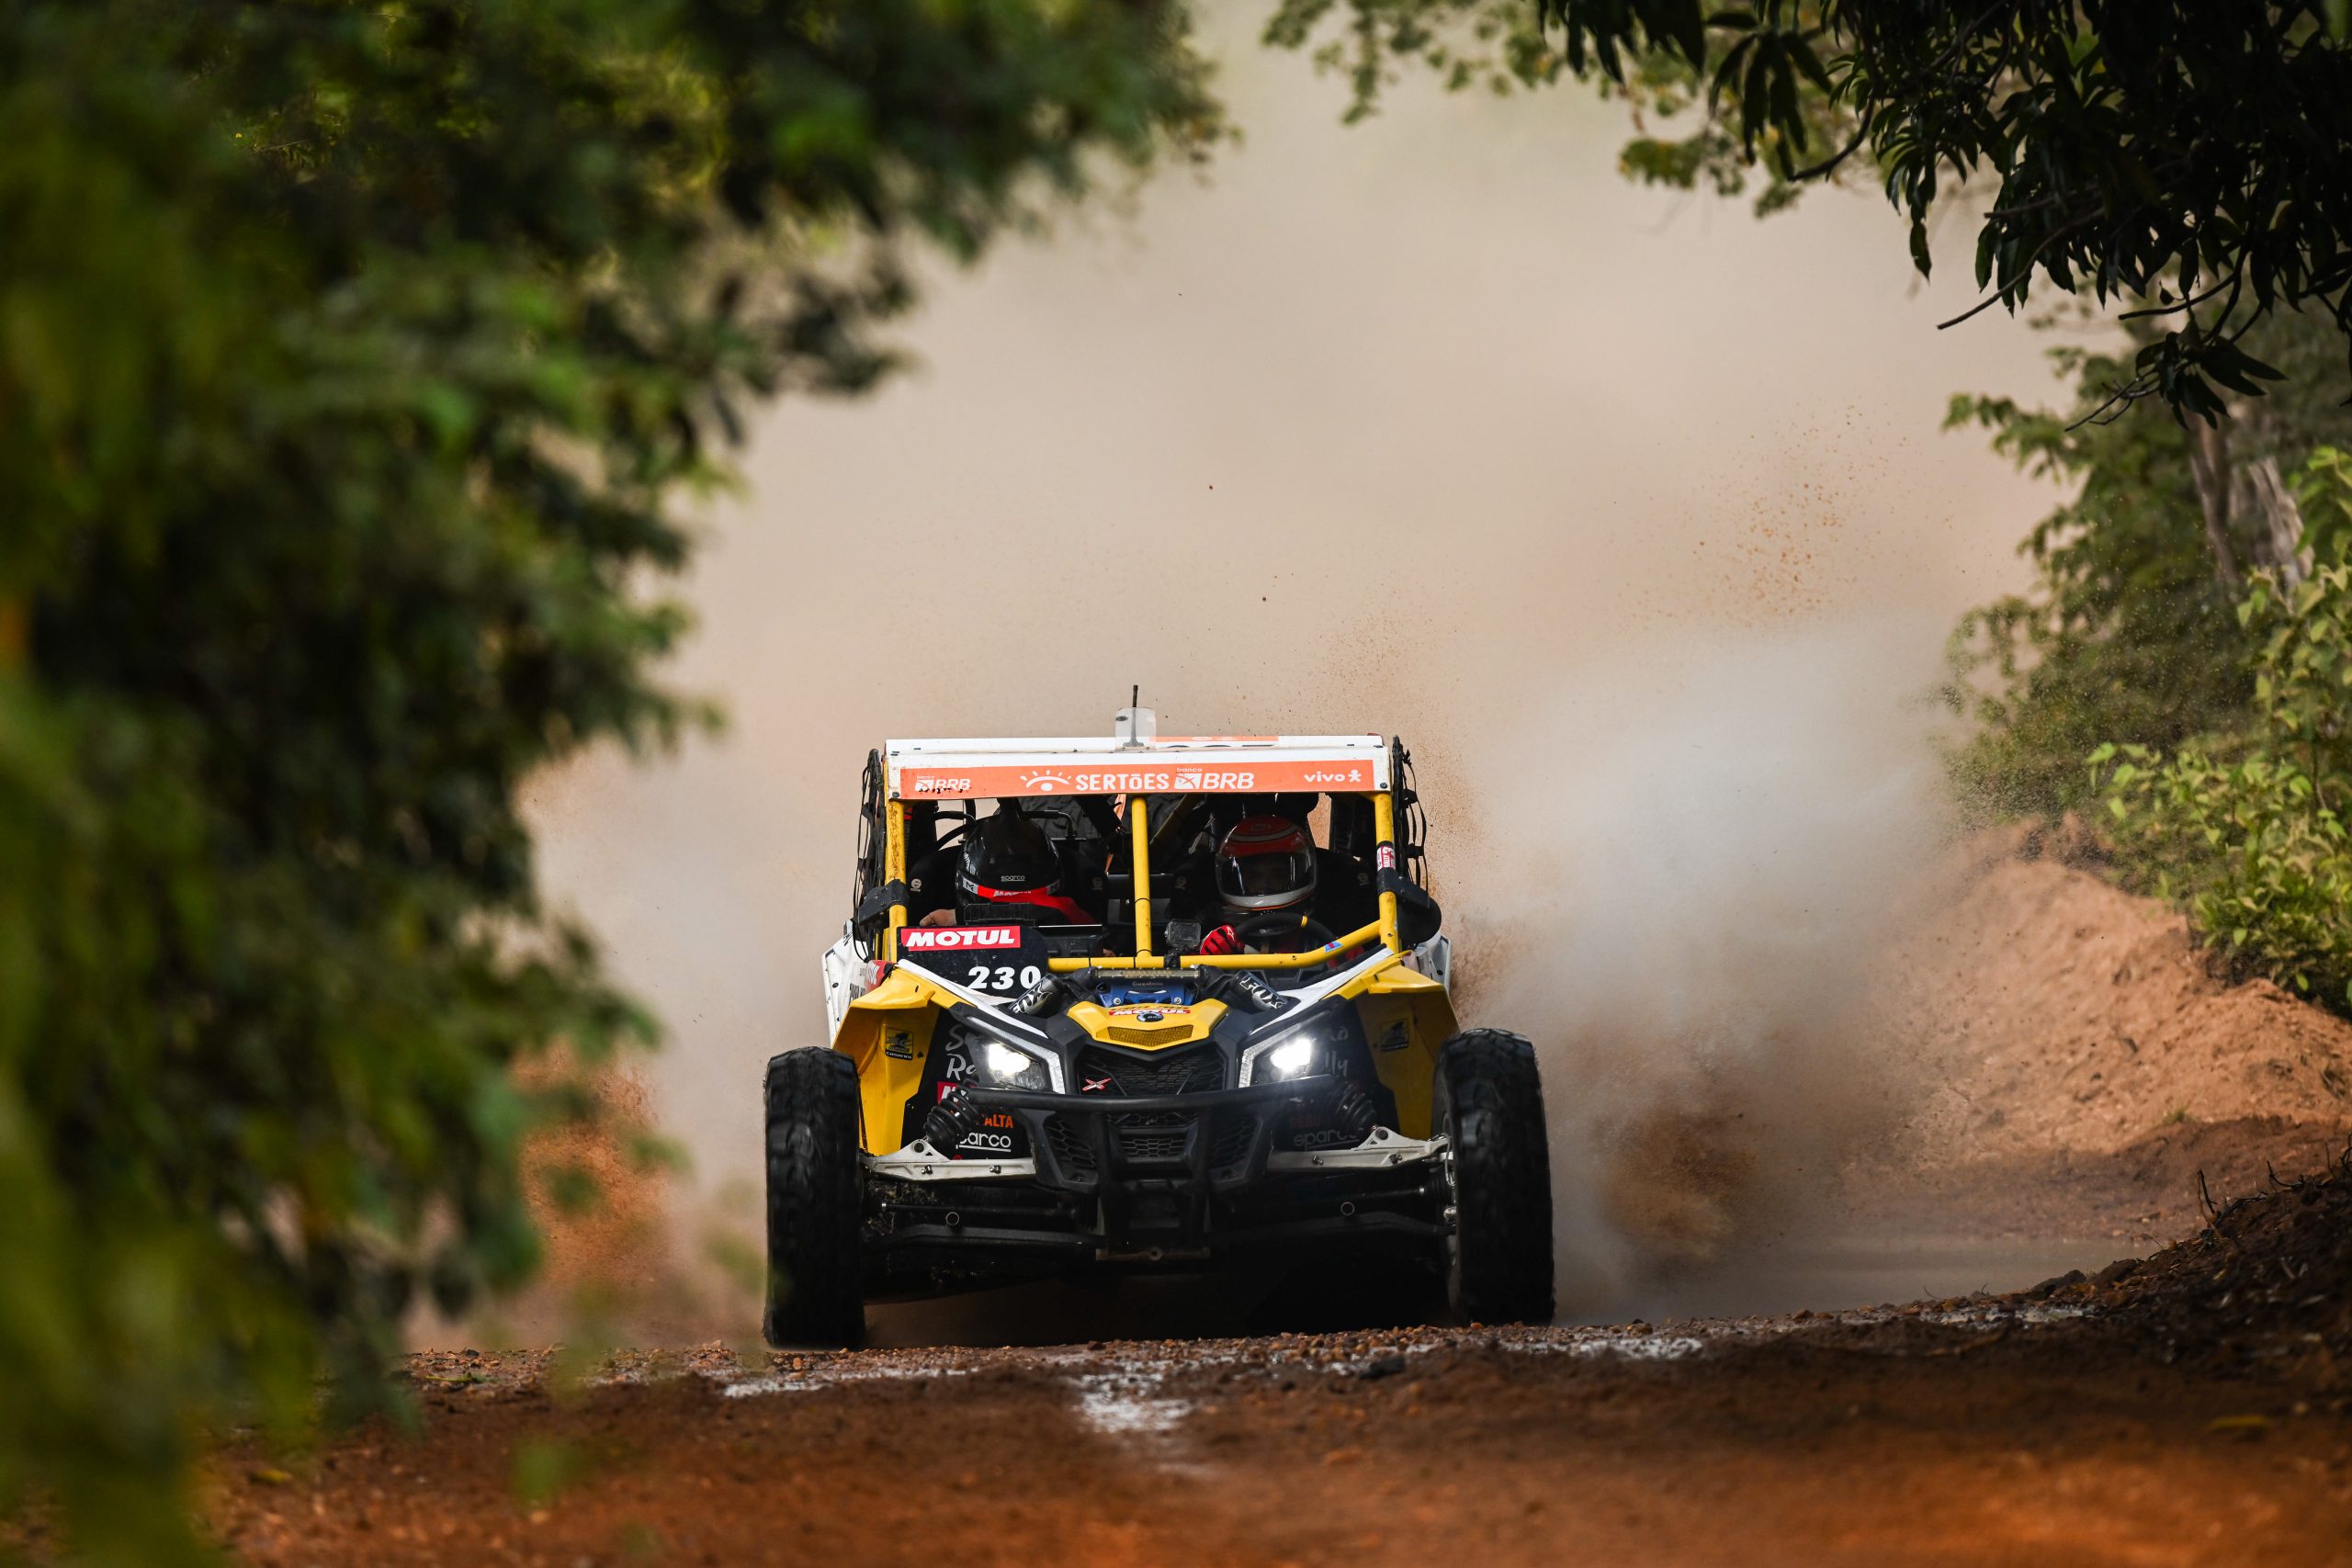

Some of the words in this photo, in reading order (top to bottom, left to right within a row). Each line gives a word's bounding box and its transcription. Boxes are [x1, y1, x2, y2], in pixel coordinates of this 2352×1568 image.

[935, 778, 971, 793] BRB
[1204, 773, 1254, 790] BRB
[1304, 771, 1346, 783] vivo
[906, 930, 1015, 947] MOTUL
[967, 965, 1042, 990] 230
[956, 1132, 1012, 1153] arco
